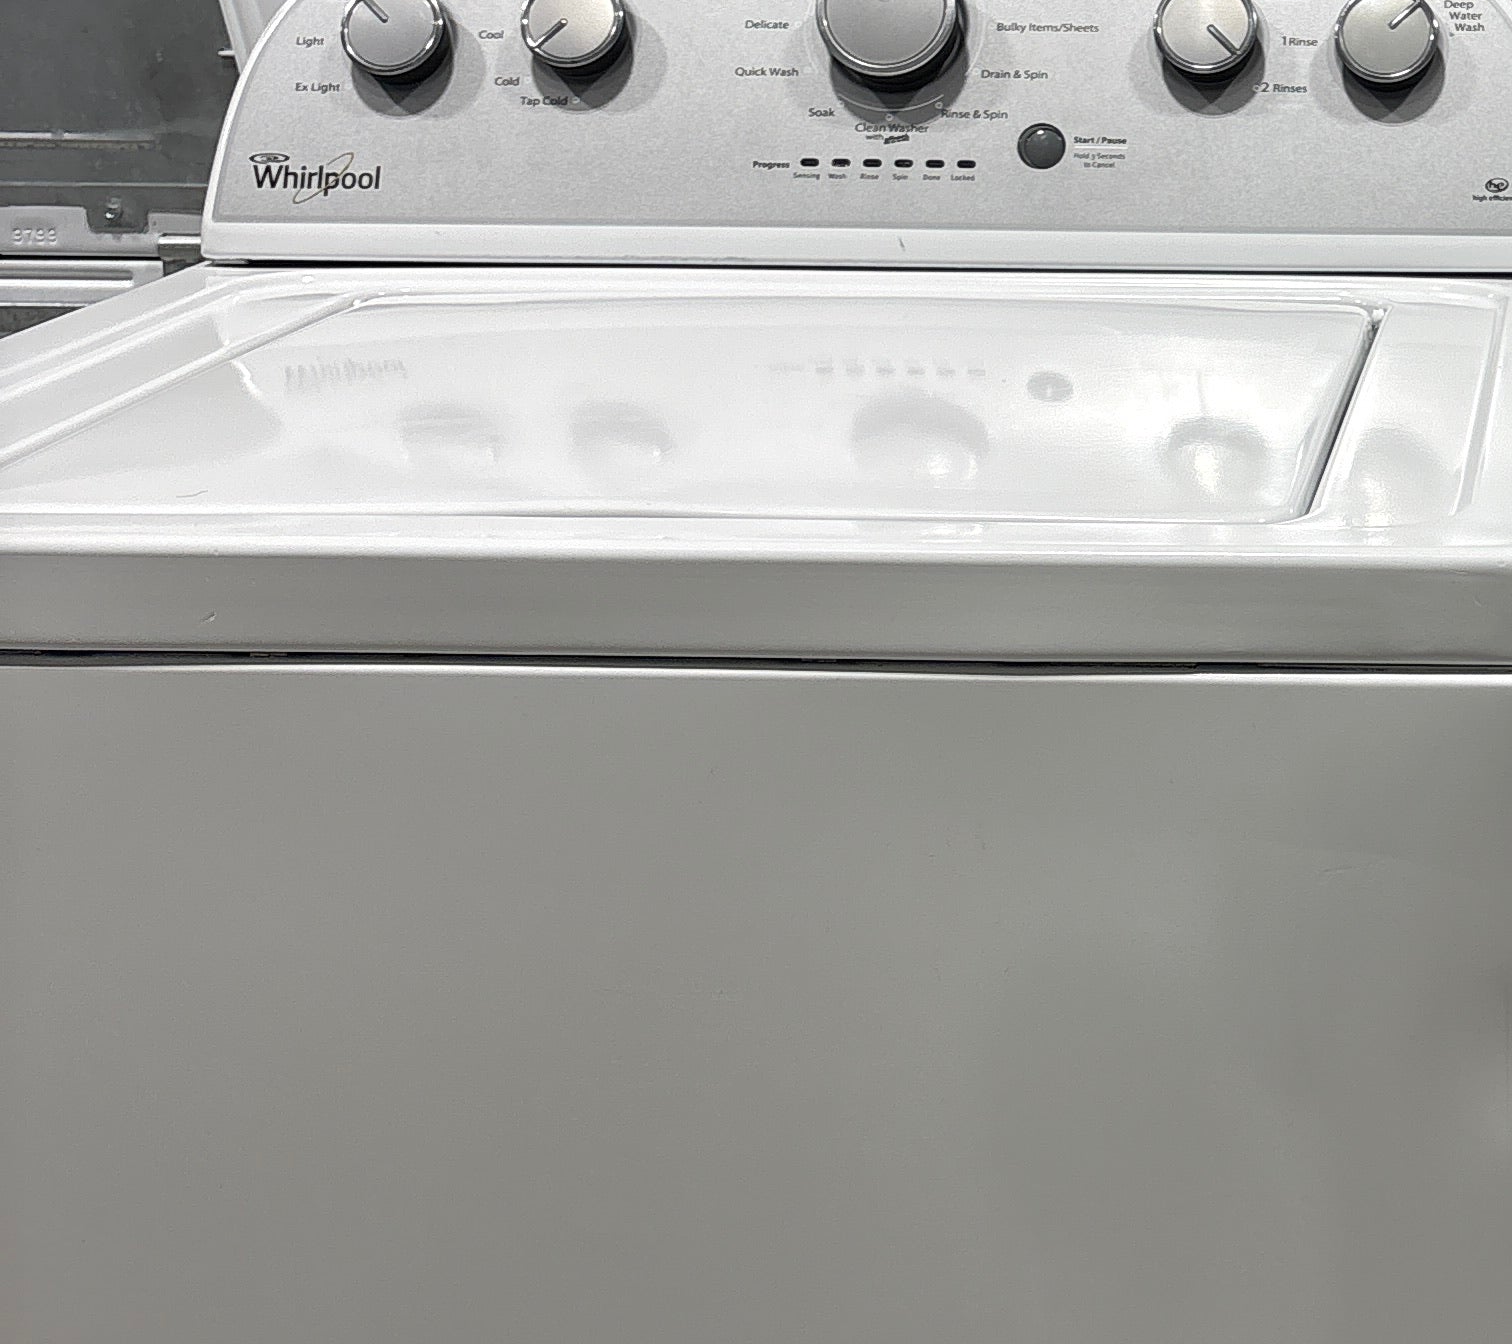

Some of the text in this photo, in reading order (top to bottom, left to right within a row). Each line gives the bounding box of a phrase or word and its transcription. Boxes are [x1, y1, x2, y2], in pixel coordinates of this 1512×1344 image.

[1444, 0, 1473, 11] Deep
[1449, 11, 1482, 21] Water
[745, 20, 789, 29] Delicate
[997, 23, 1099, 33] Bulky Items/Sheets
[1455, 22, 1485, 31] Wash
[479, 30, 504, 39] Cool
[296, 36, 324, 47] Light
[1282, 37, 1318, 46] 1 Rinse
[735, 67, 798, 78] Quick Wash
[981, 70, 1048, 81] Drain & Spin
[495, 77, 519, 86] Cold
[295, 82, 340, 94] Ex Light
[1261, 83, 1307, 93] 2 Rinses
[520, 96, 568, 107] Tap Cold
[808, 107, 835, 117] Soak
[941, 109, 1008, 120] Rinse & Spin
[855, 123, 929, 133] Clean Washer
[1074, 136, 1094, 144] Start
[752, 161, 790, 170] Progress
[253, 164, 380, 196] Whirlpool
